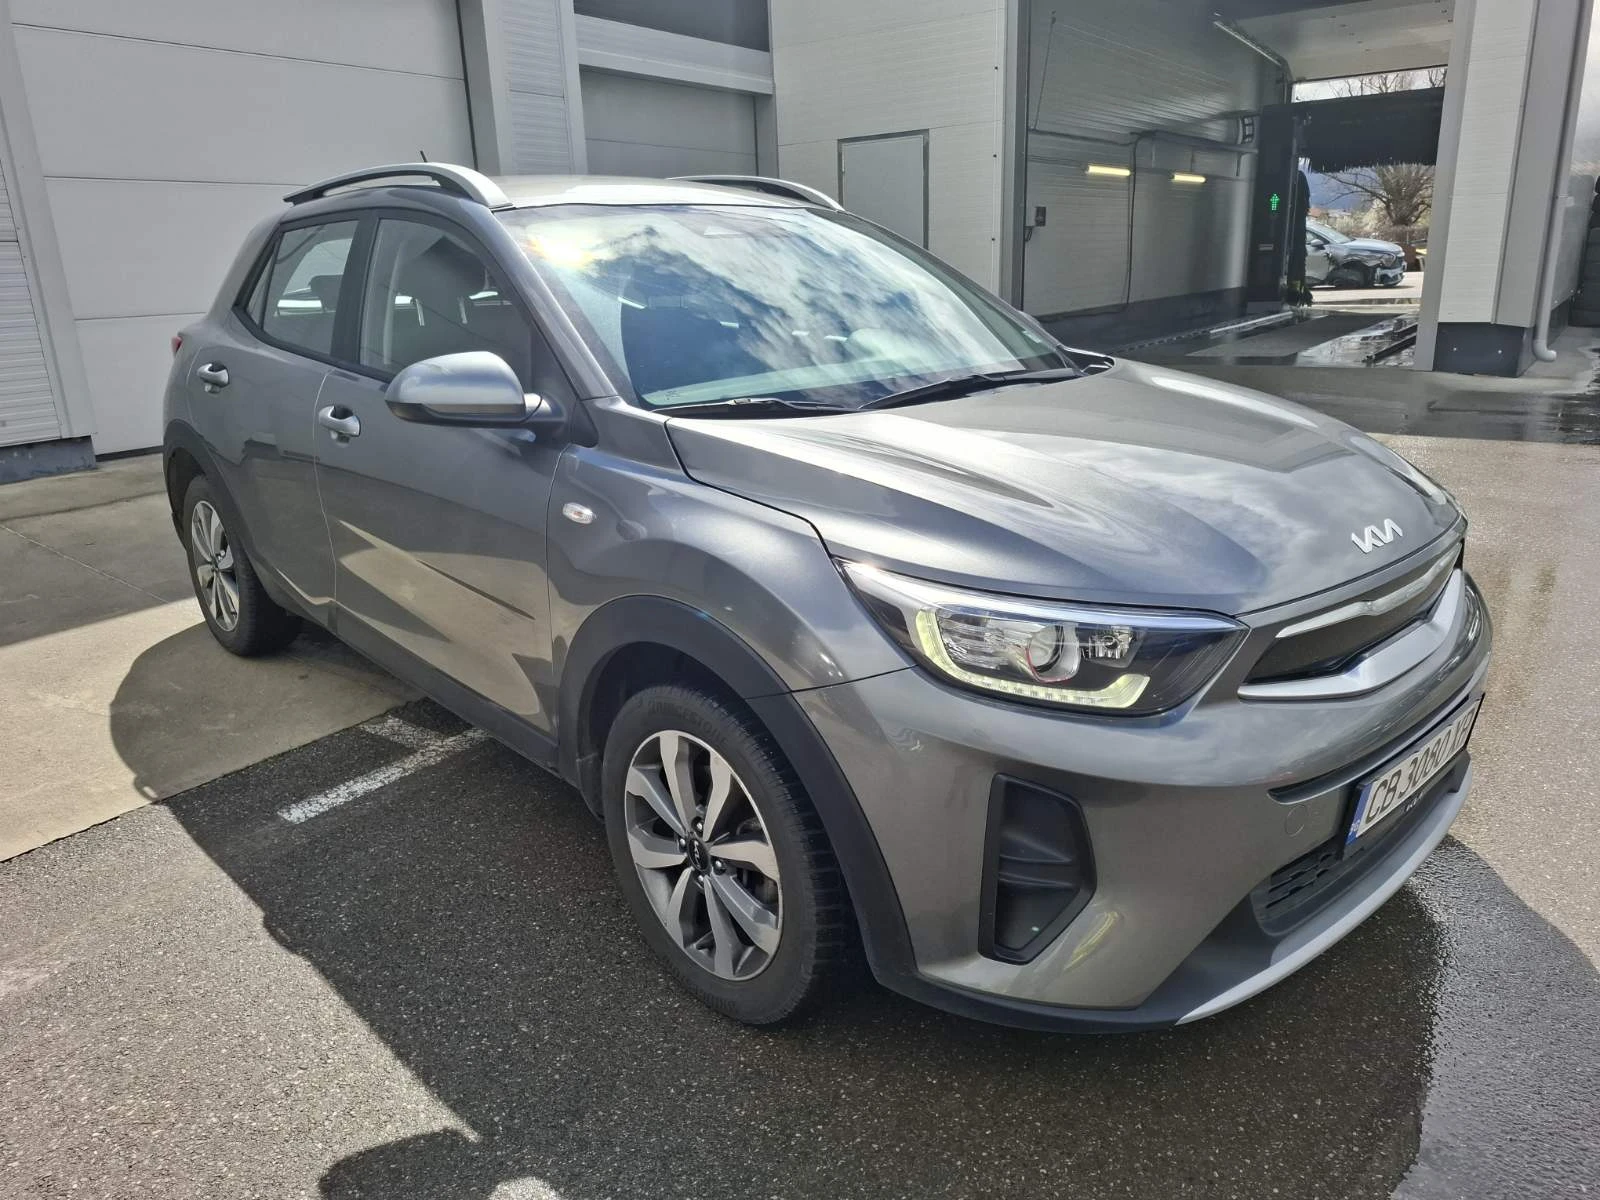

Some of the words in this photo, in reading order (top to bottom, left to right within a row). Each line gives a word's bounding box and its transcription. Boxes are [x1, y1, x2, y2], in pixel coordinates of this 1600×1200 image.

[1351, 518, 1403, 553] KIA
[1366, 769, 1402, 824] CB
[1400, 729, 1452, 799] 3080
